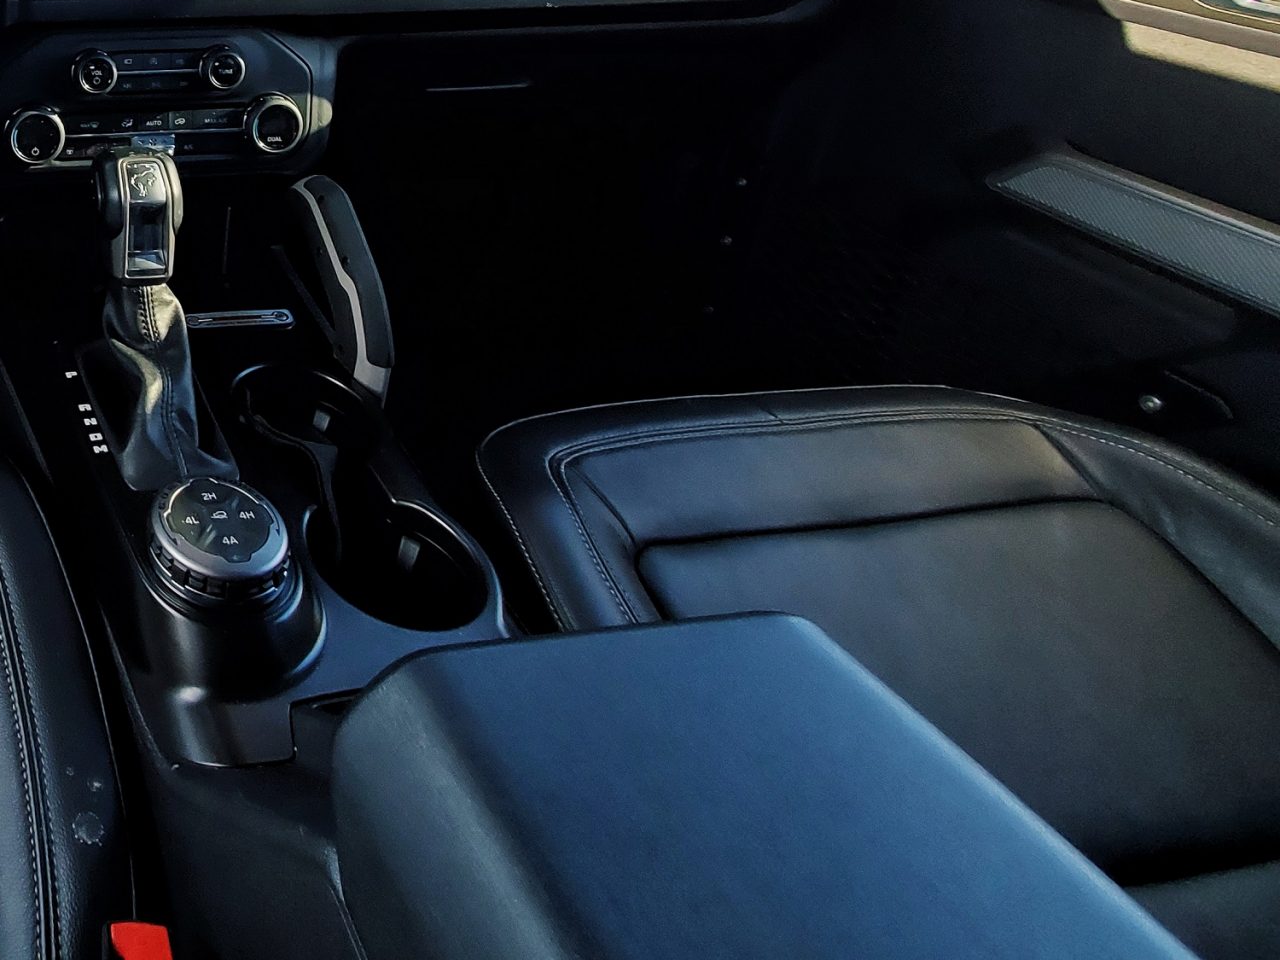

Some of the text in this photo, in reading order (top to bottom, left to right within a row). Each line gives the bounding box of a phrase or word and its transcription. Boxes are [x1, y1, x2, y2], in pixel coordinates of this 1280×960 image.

[83, 417, 98, 426] N
[92, 444, 109, 454] M
[201, 492, 217, 501] 2H
[185, 511, 255, 525] 4L 4H
[222, 535, 239, 545] 4A
